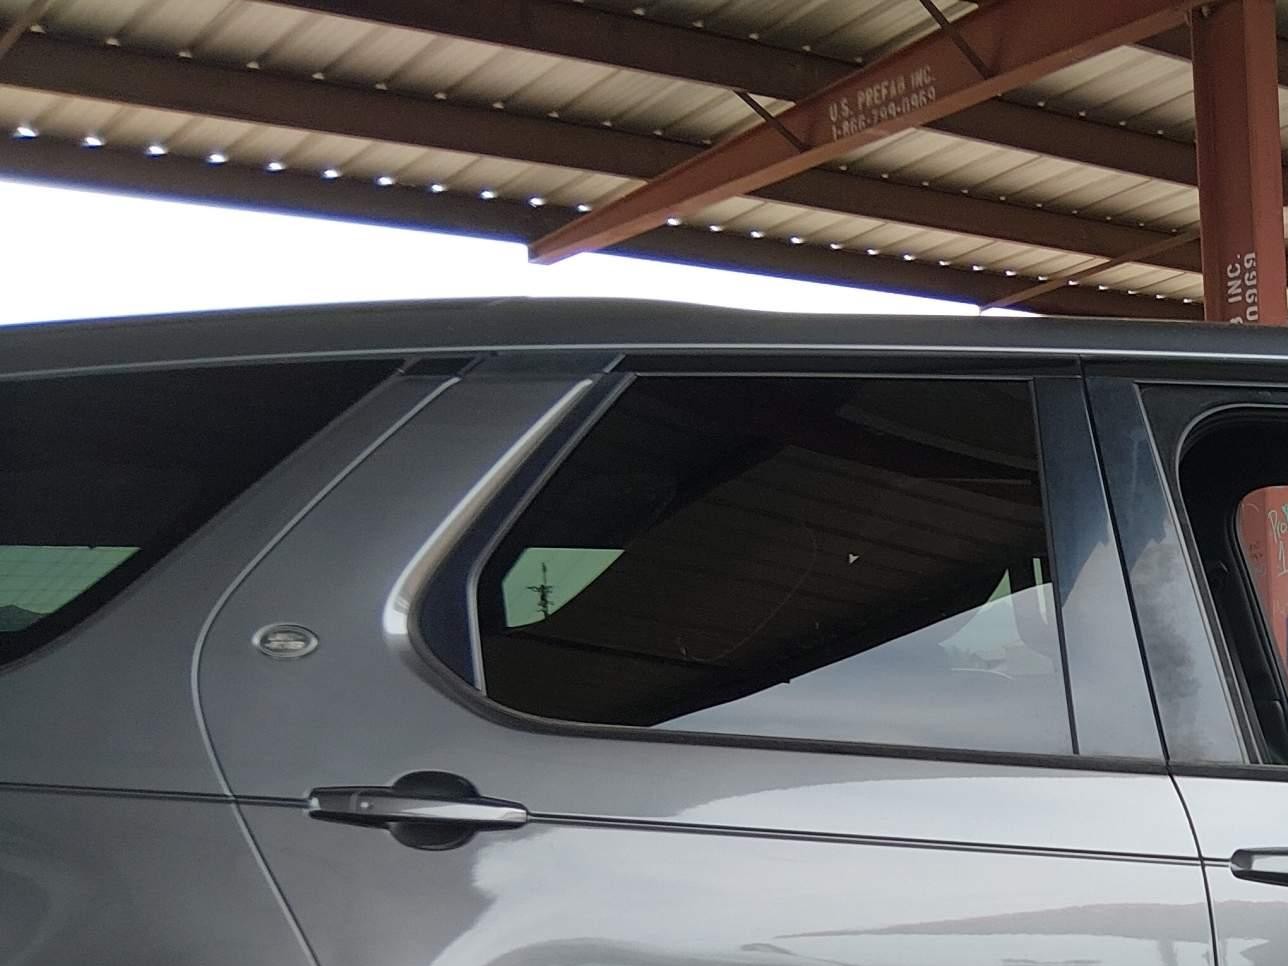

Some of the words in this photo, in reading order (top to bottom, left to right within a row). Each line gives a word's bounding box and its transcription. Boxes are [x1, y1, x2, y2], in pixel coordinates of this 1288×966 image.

[857, 76, 906, 110] PREFAB
[911, 65, 937, 88] INC.
[1227, 254, 1242, 303] INC.
